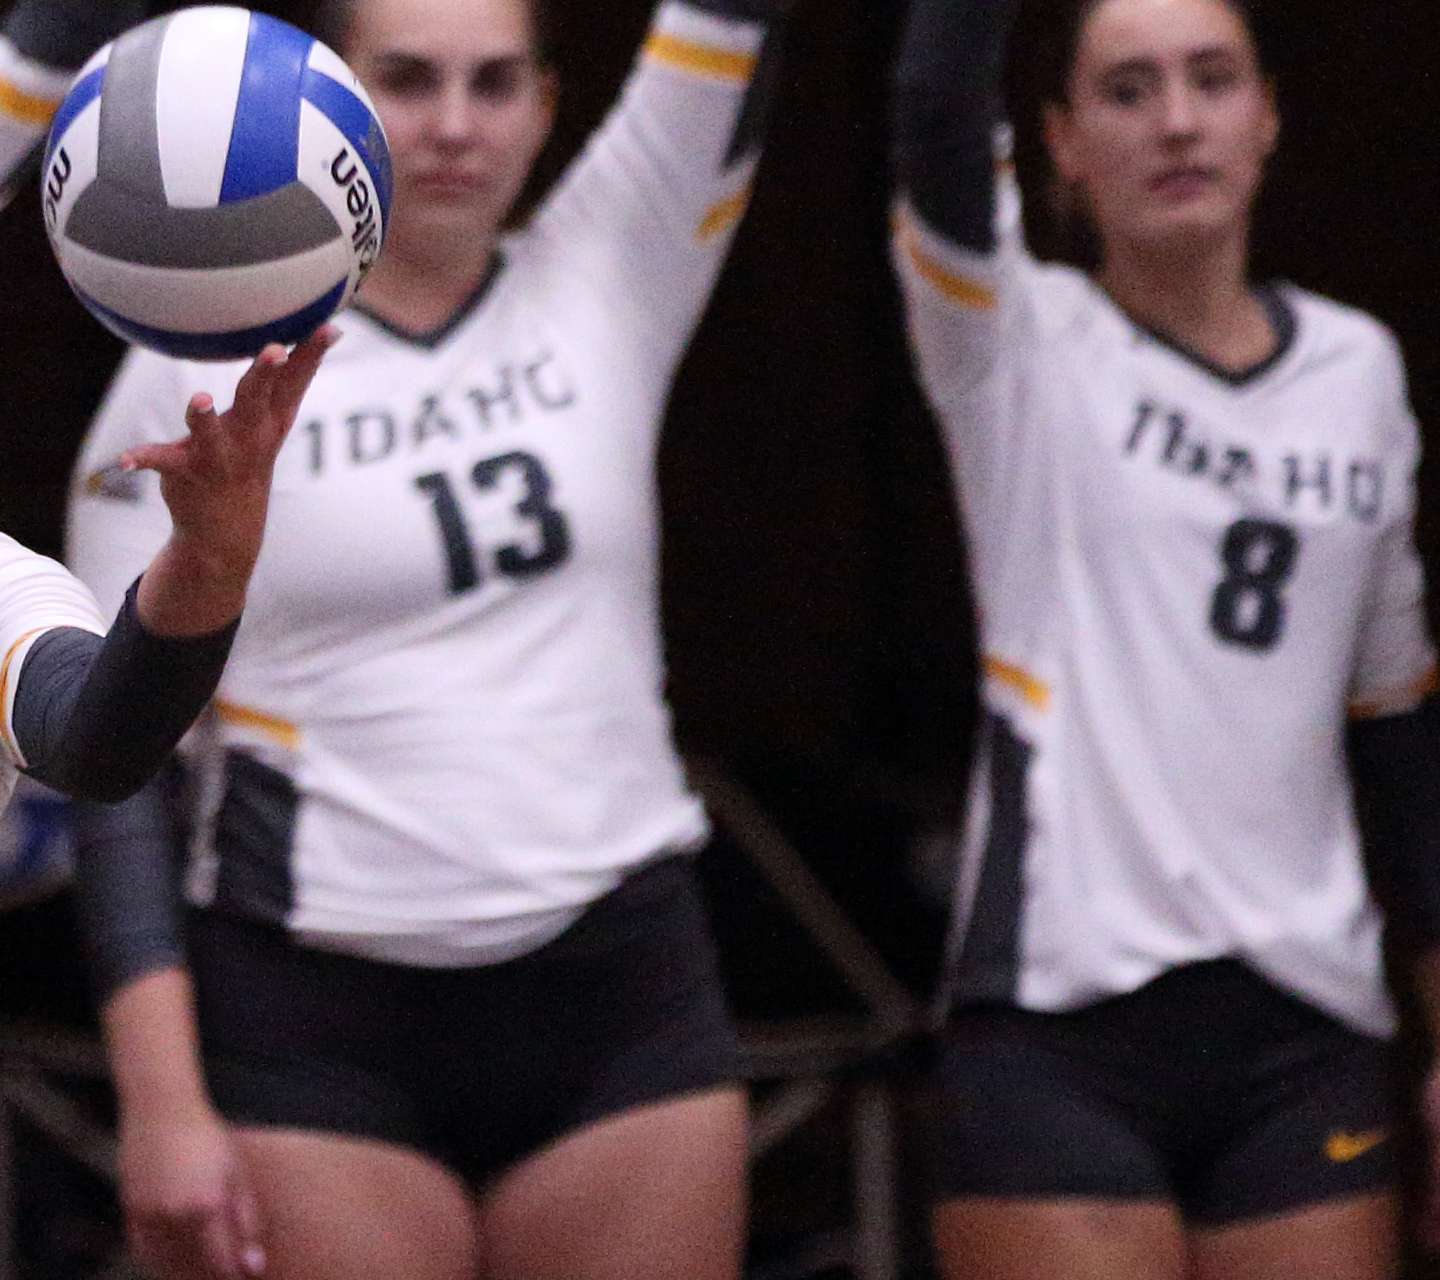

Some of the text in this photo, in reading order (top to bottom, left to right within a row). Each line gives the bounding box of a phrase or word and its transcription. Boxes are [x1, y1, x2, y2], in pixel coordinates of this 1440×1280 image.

[304, 348, 578, 476] IDAHO
[415, 451, 573, 594] 13
[1209, 518, 1300, 654] 8
